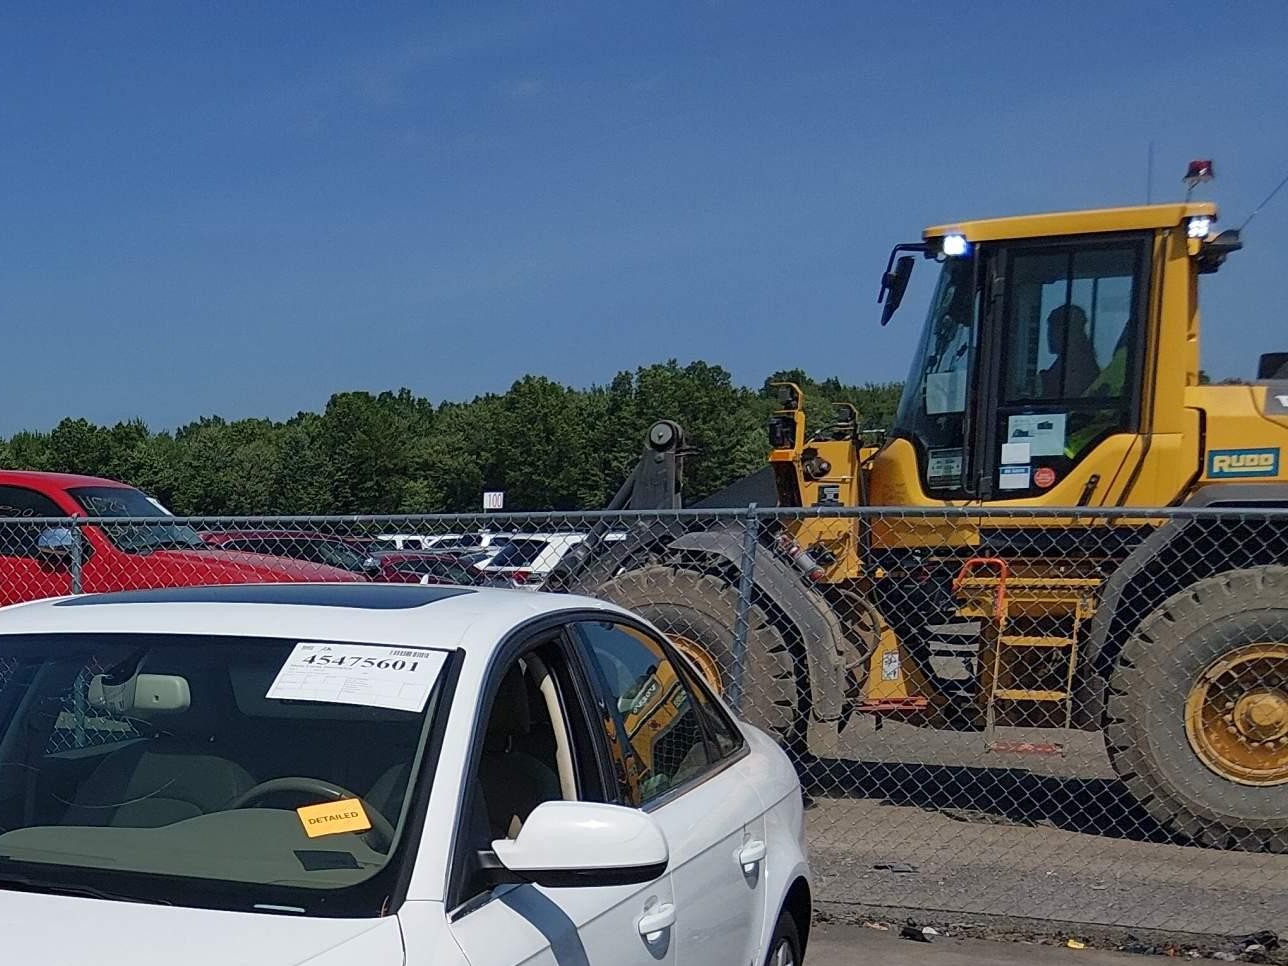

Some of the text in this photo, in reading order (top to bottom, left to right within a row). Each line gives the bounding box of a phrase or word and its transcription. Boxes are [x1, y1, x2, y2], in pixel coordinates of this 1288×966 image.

[1213, 453, 1274, 473] RUDD
[488, 493, 502, 508] 100
[303, 654, 420, 673] 45475601
[308, 811, 359, 825] DETAILED
